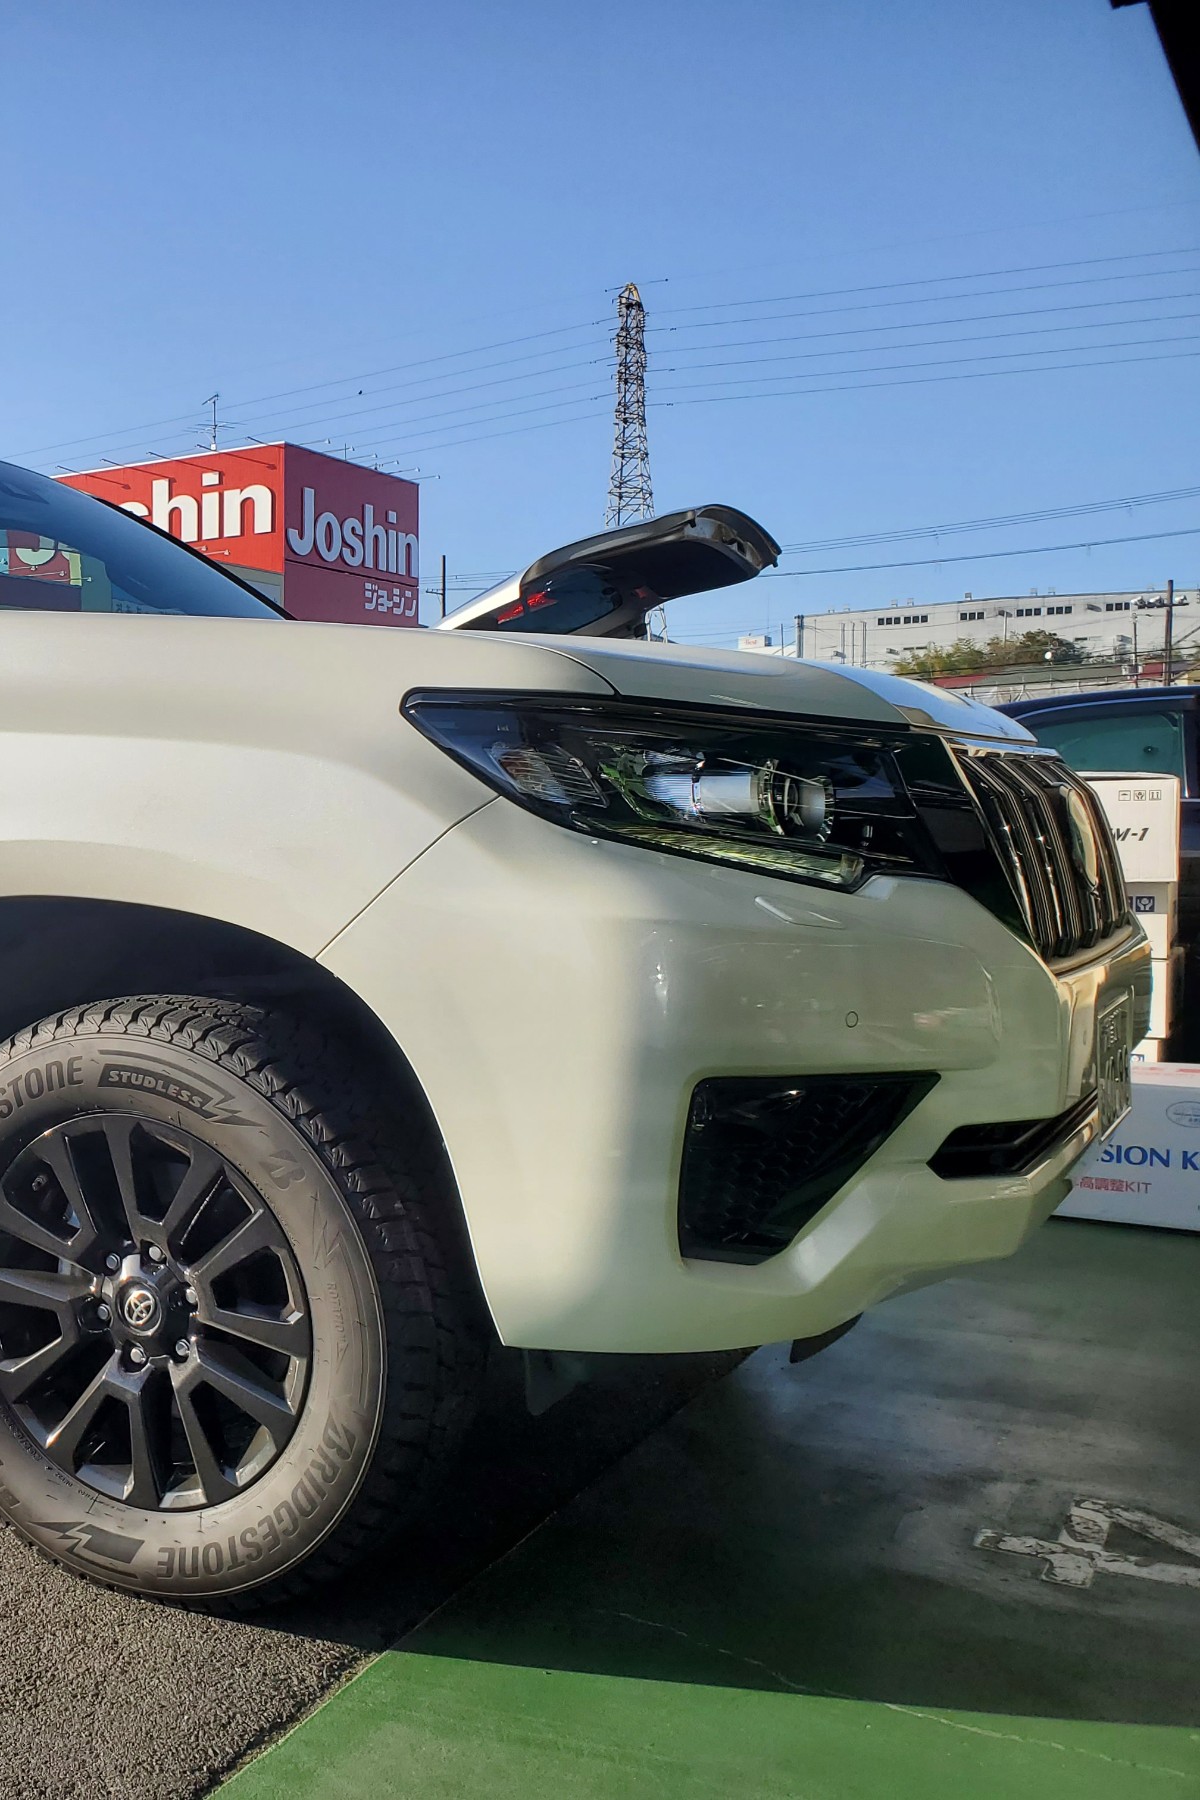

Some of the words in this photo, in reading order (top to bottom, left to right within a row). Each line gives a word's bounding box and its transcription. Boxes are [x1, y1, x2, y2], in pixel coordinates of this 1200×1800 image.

[287, 487, 418, 577] Joshin
[364, 582, 417, 617] ジョーシン
[108, 1070, 203, 1108] STUDLESS
[1100, 1143, 1171, 1168] SION
[1077, 1176, 1153, 1194] 高調整KIT
[156, 1410, 357, 1580] BRIDGESTONE
